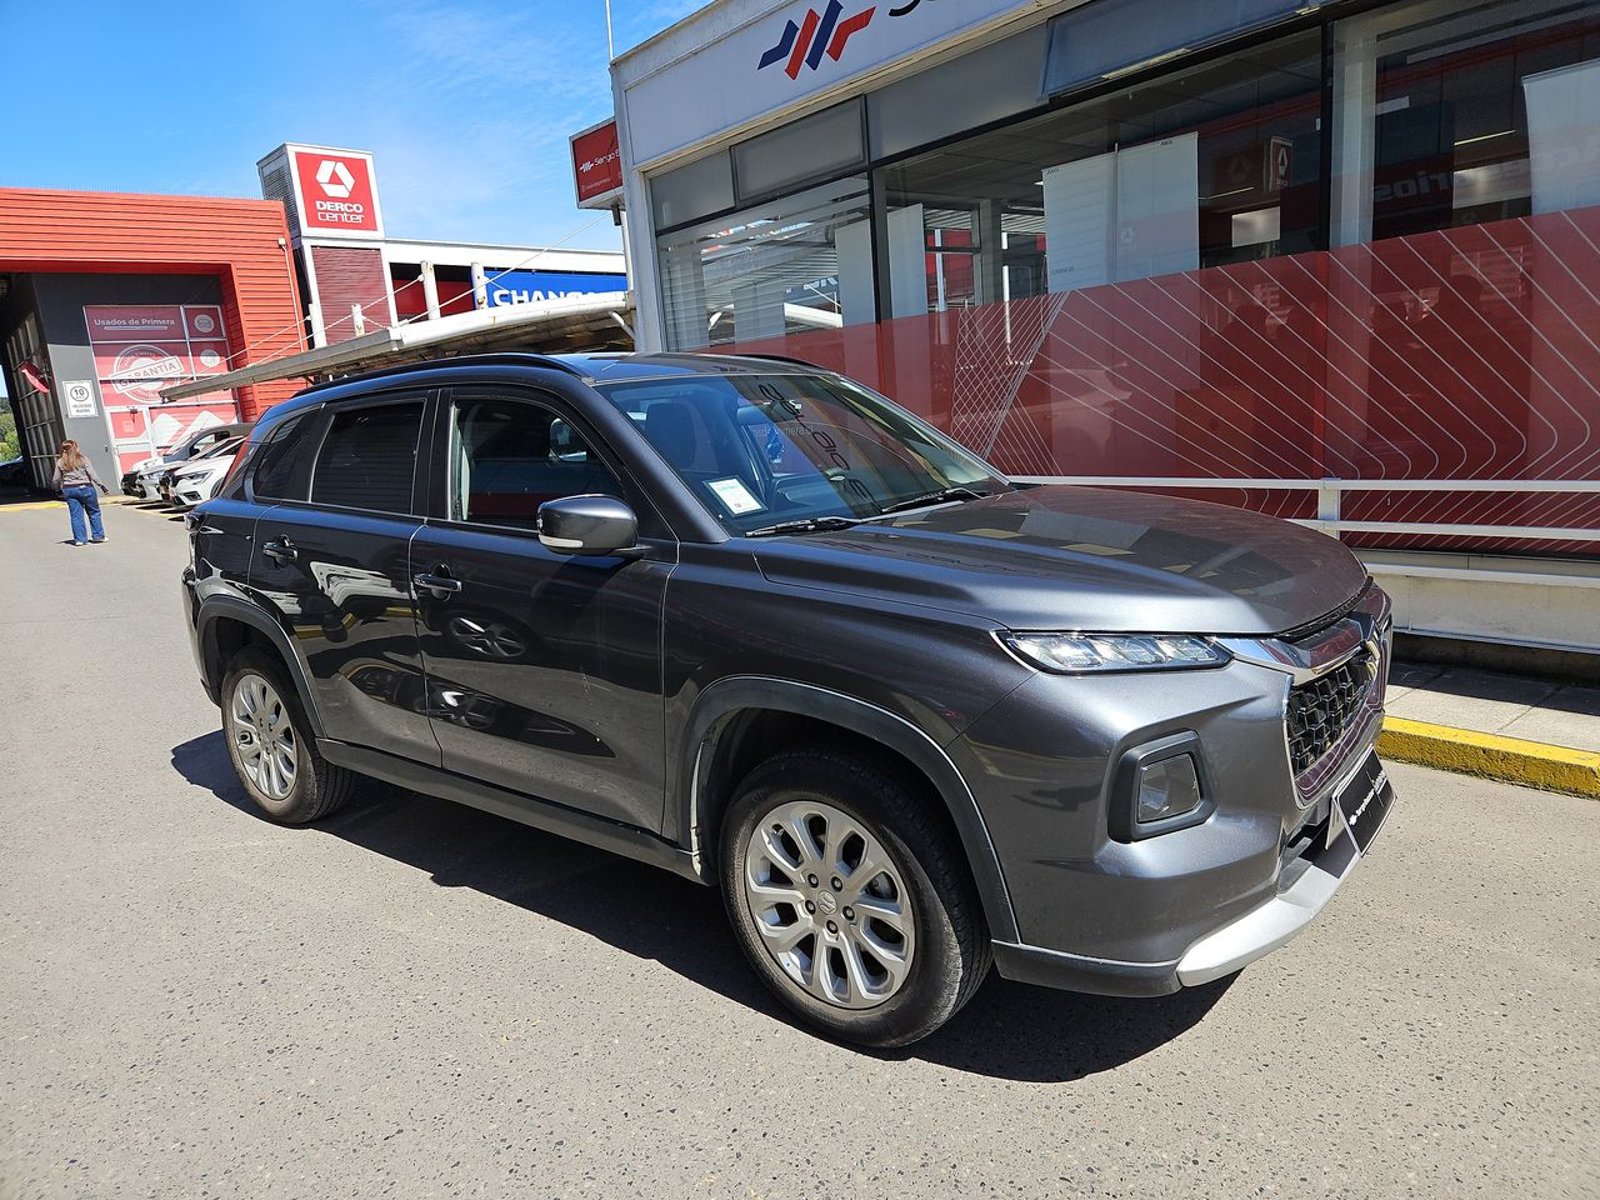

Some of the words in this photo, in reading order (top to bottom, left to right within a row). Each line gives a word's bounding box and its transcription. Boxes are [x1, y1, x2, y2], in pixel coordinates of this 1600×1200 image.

[315, 200, 364, 213] DERCO
[317, 211, 365, 223] center
[493, 289, 597, 306] CHAN
[93, 318, 127, 326] Usados
[128, 317, 140, 326] de
[141, 317, 176, 326] Primera
[74, 388, 85, 396] 10
